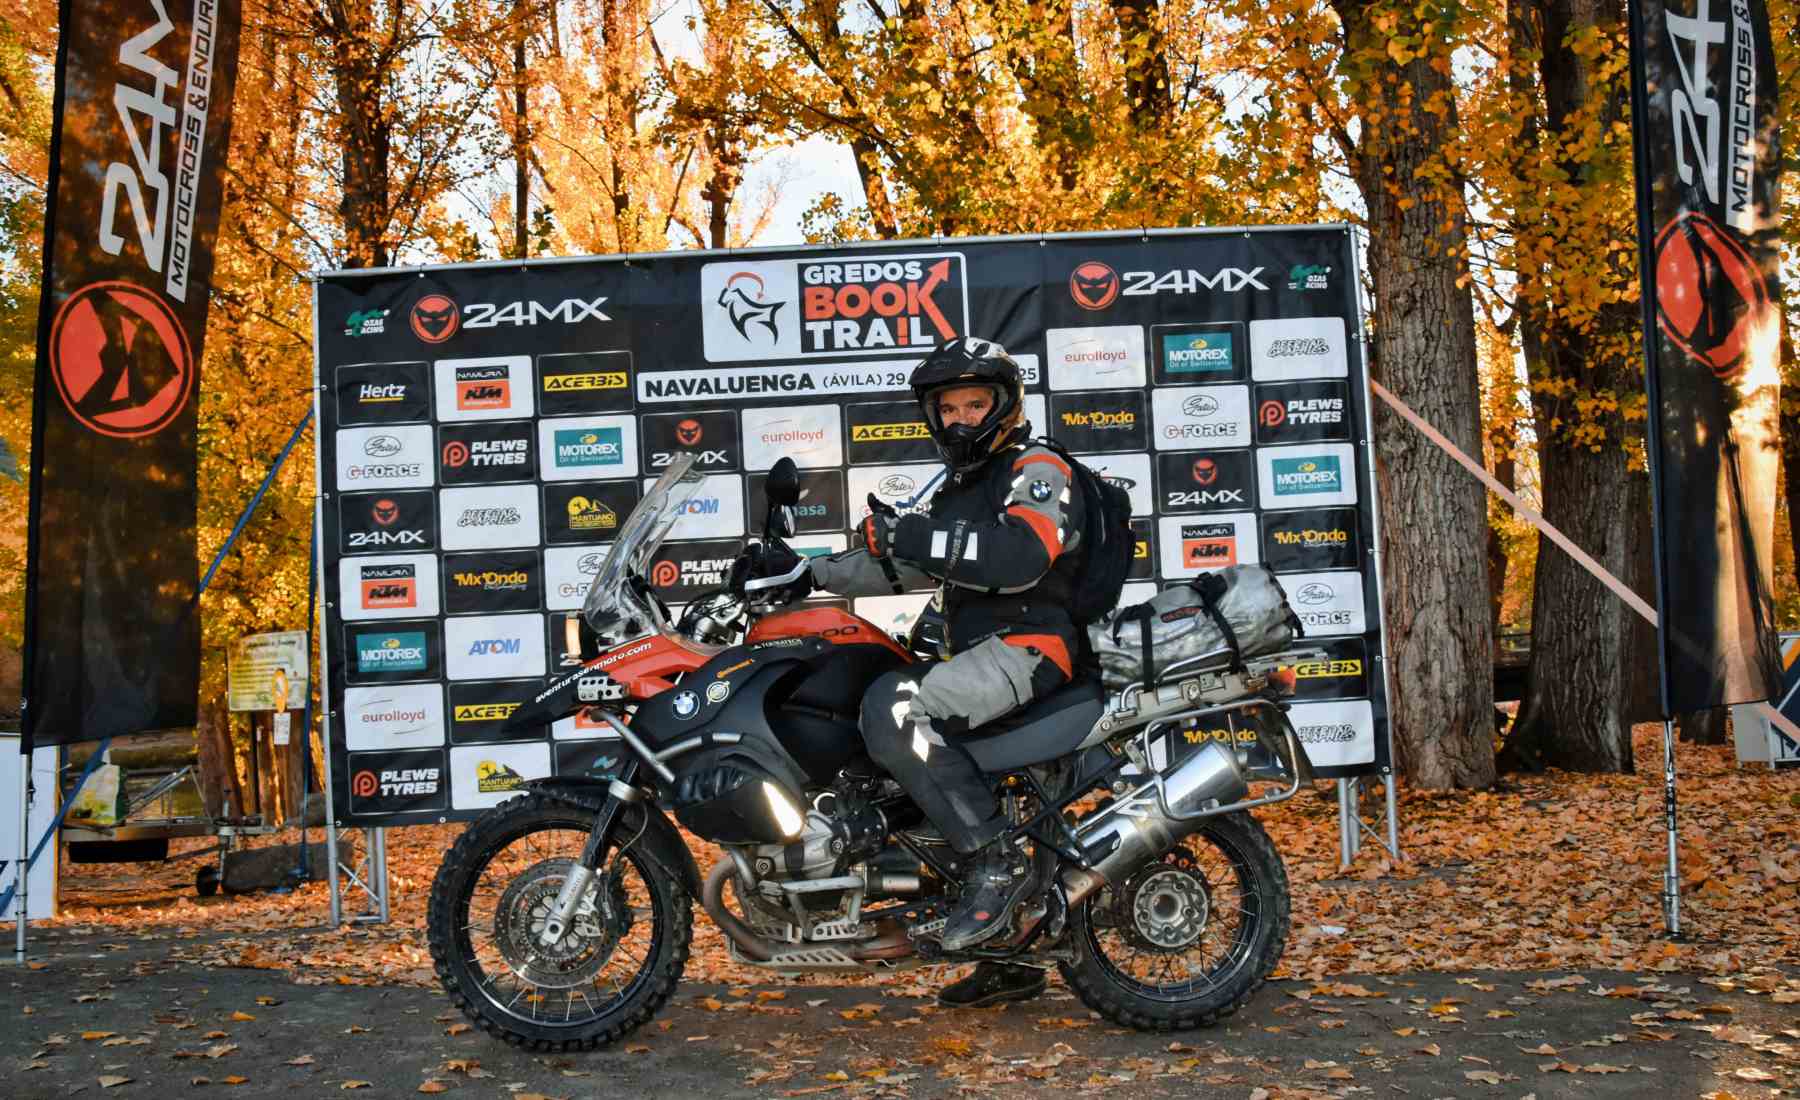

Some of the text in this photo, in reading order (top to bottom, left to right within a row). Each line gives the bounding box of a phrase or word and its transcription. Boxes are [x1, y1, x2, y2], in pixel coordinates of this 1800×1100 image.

[1732, 28, 1751, 212] MOTOCROSS
[171, 0, 214, 286] MOTOCROSS & ENDUR
[804, 261, 922, 284] GREDOS
[1123, 267, 1270, 296] 24MX
[462, 297, 612, 328] 24MX
[1065, 348, 1126, 364] eurolloyd
[1169, 348, 1228, 361] MOTOREX
[360, 384, 406, 399] Hertz
[645, 372, 815, 398] NAVALUENGA
[823, 372, 882, 389] (ÁVILA)
[886, 372, 905, 385] 29
[465, 386, 503, 400] KTM
[1287, 399, 1343, 412] PLEWS
[1287, 411, 1342, 425] TYRES
[762, 429, 824, 445] eurolloyd
[1164, 423, 1238, 440] G-FORCE
[471, 440, 528, 453] PLEWS
[559, 443, 618, 456] MOTOREX
[471, 452, 527, 466] TYRES
[651, 450, 729, 467] 2MX
[347, 464, 421, 480] G-FORCE
[1277, 470, 1337, 485] MOTOREX
[1168, 489, 1244, 506] 24MX
[349, 530, 425, 546] 24MX
[1190, 544, 1229, 558] KTM
[681, 572, 722, 586] TYRE
[469, 638, 521, 656] ATOM
[361, 648, 422, 662] MOTOREX
[536, 642, 652, 703] aventurasenmoto.com
[362, 709, 426, 723] eurolloyd
[381, 768, 440, 782] PLEWS
[381, 782, 438, 797] TYRES
